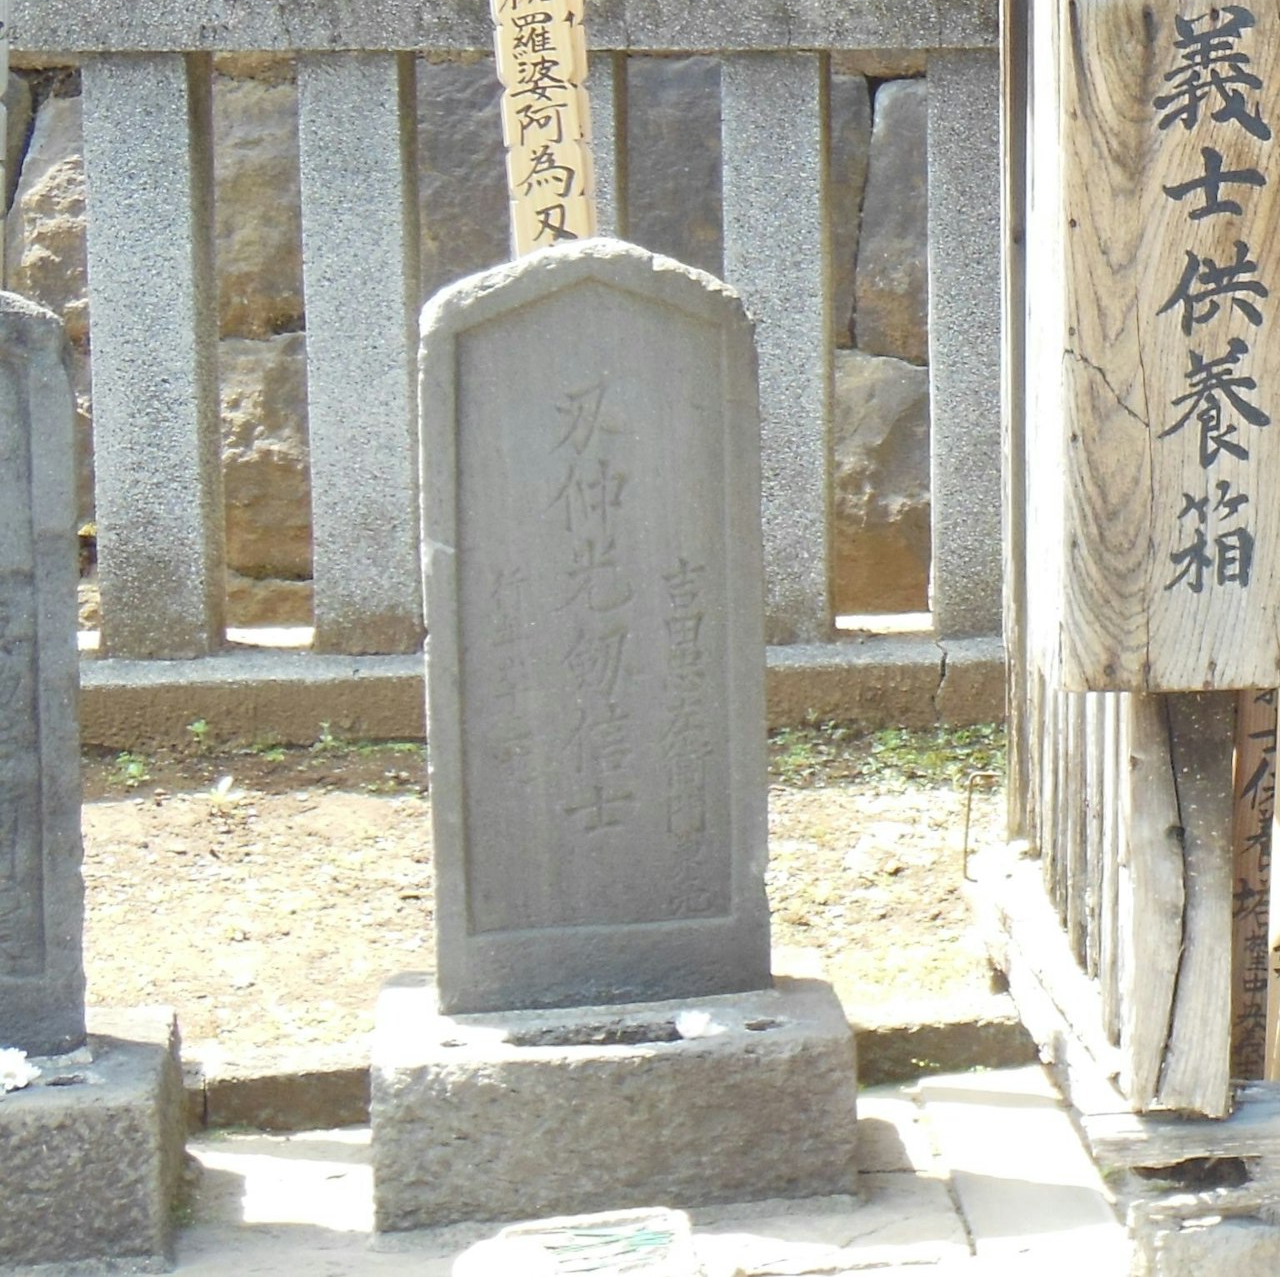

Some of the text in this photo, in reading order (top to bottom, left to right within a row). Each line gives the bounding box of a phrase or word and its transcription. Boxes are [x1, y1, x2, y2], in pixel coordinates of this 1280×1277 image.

[1153, 3, 1273, 595] 義士供養箱
